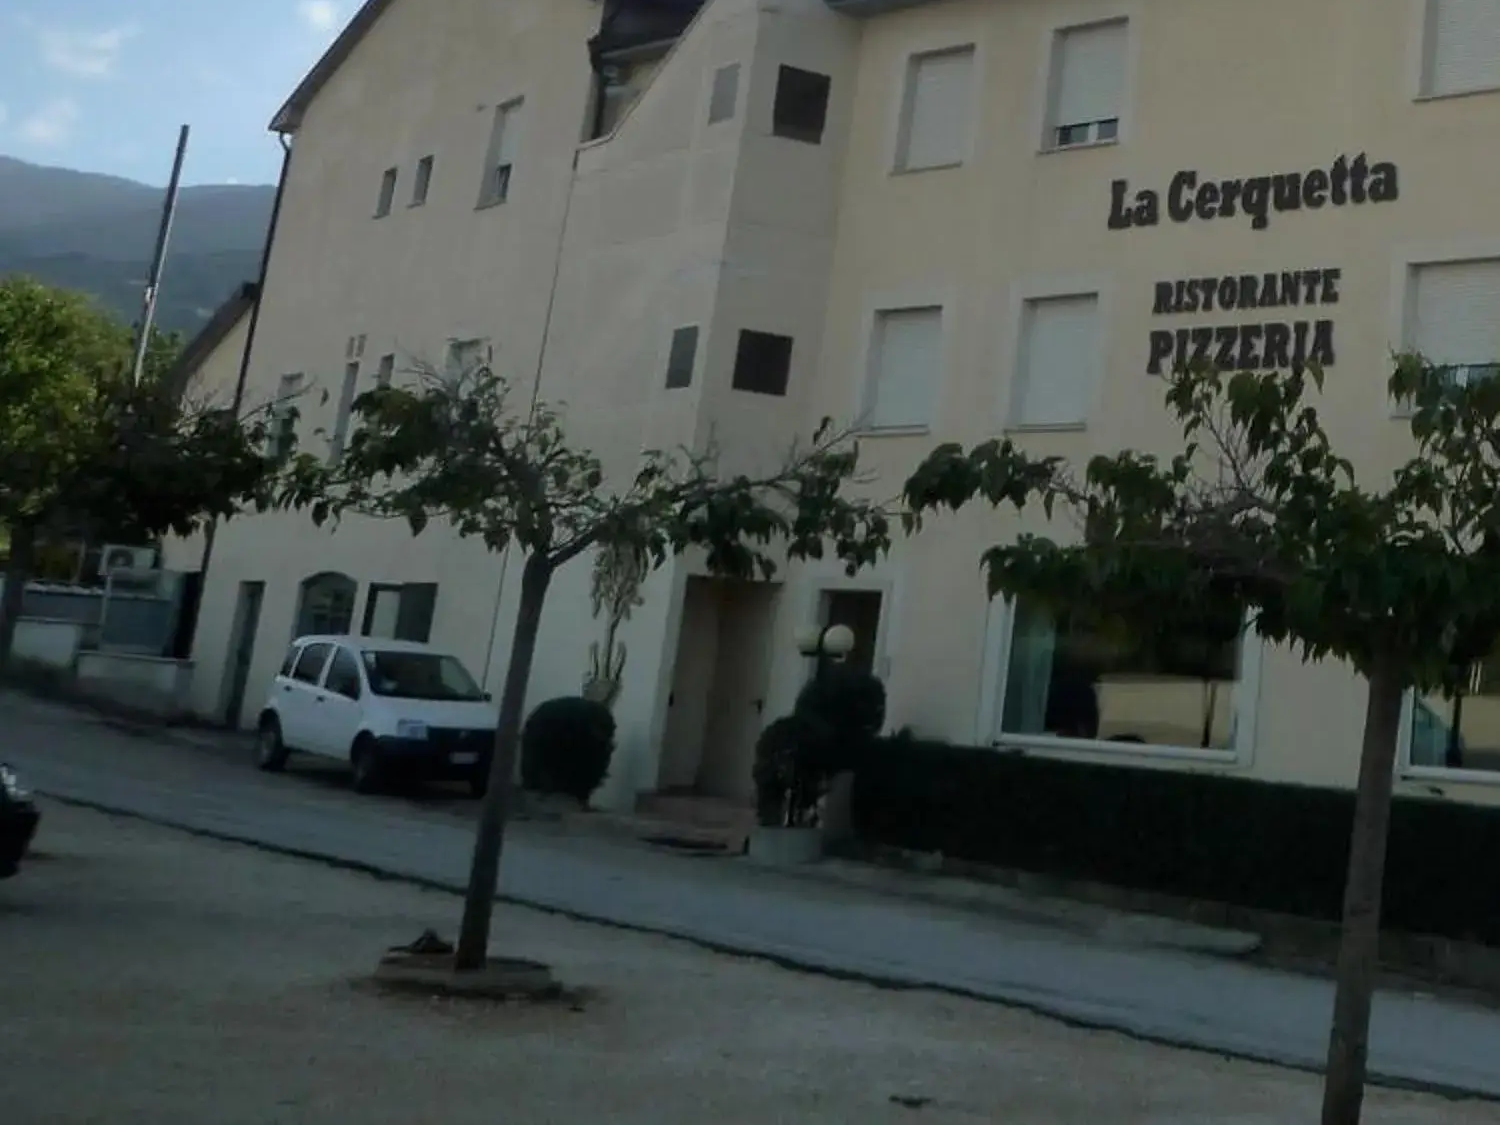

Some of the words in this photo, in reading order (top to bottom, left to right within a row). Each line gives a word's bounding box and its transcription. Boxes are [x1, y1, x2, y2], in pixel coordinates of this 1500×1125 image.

[1108, 179, 1159, 229] La
[1168, 152, 1398, 229] Cerquetta
[1152, 268, 1341, 314] RISTORANTE
[1147, 320, 1335, 375] PIZZERIA
